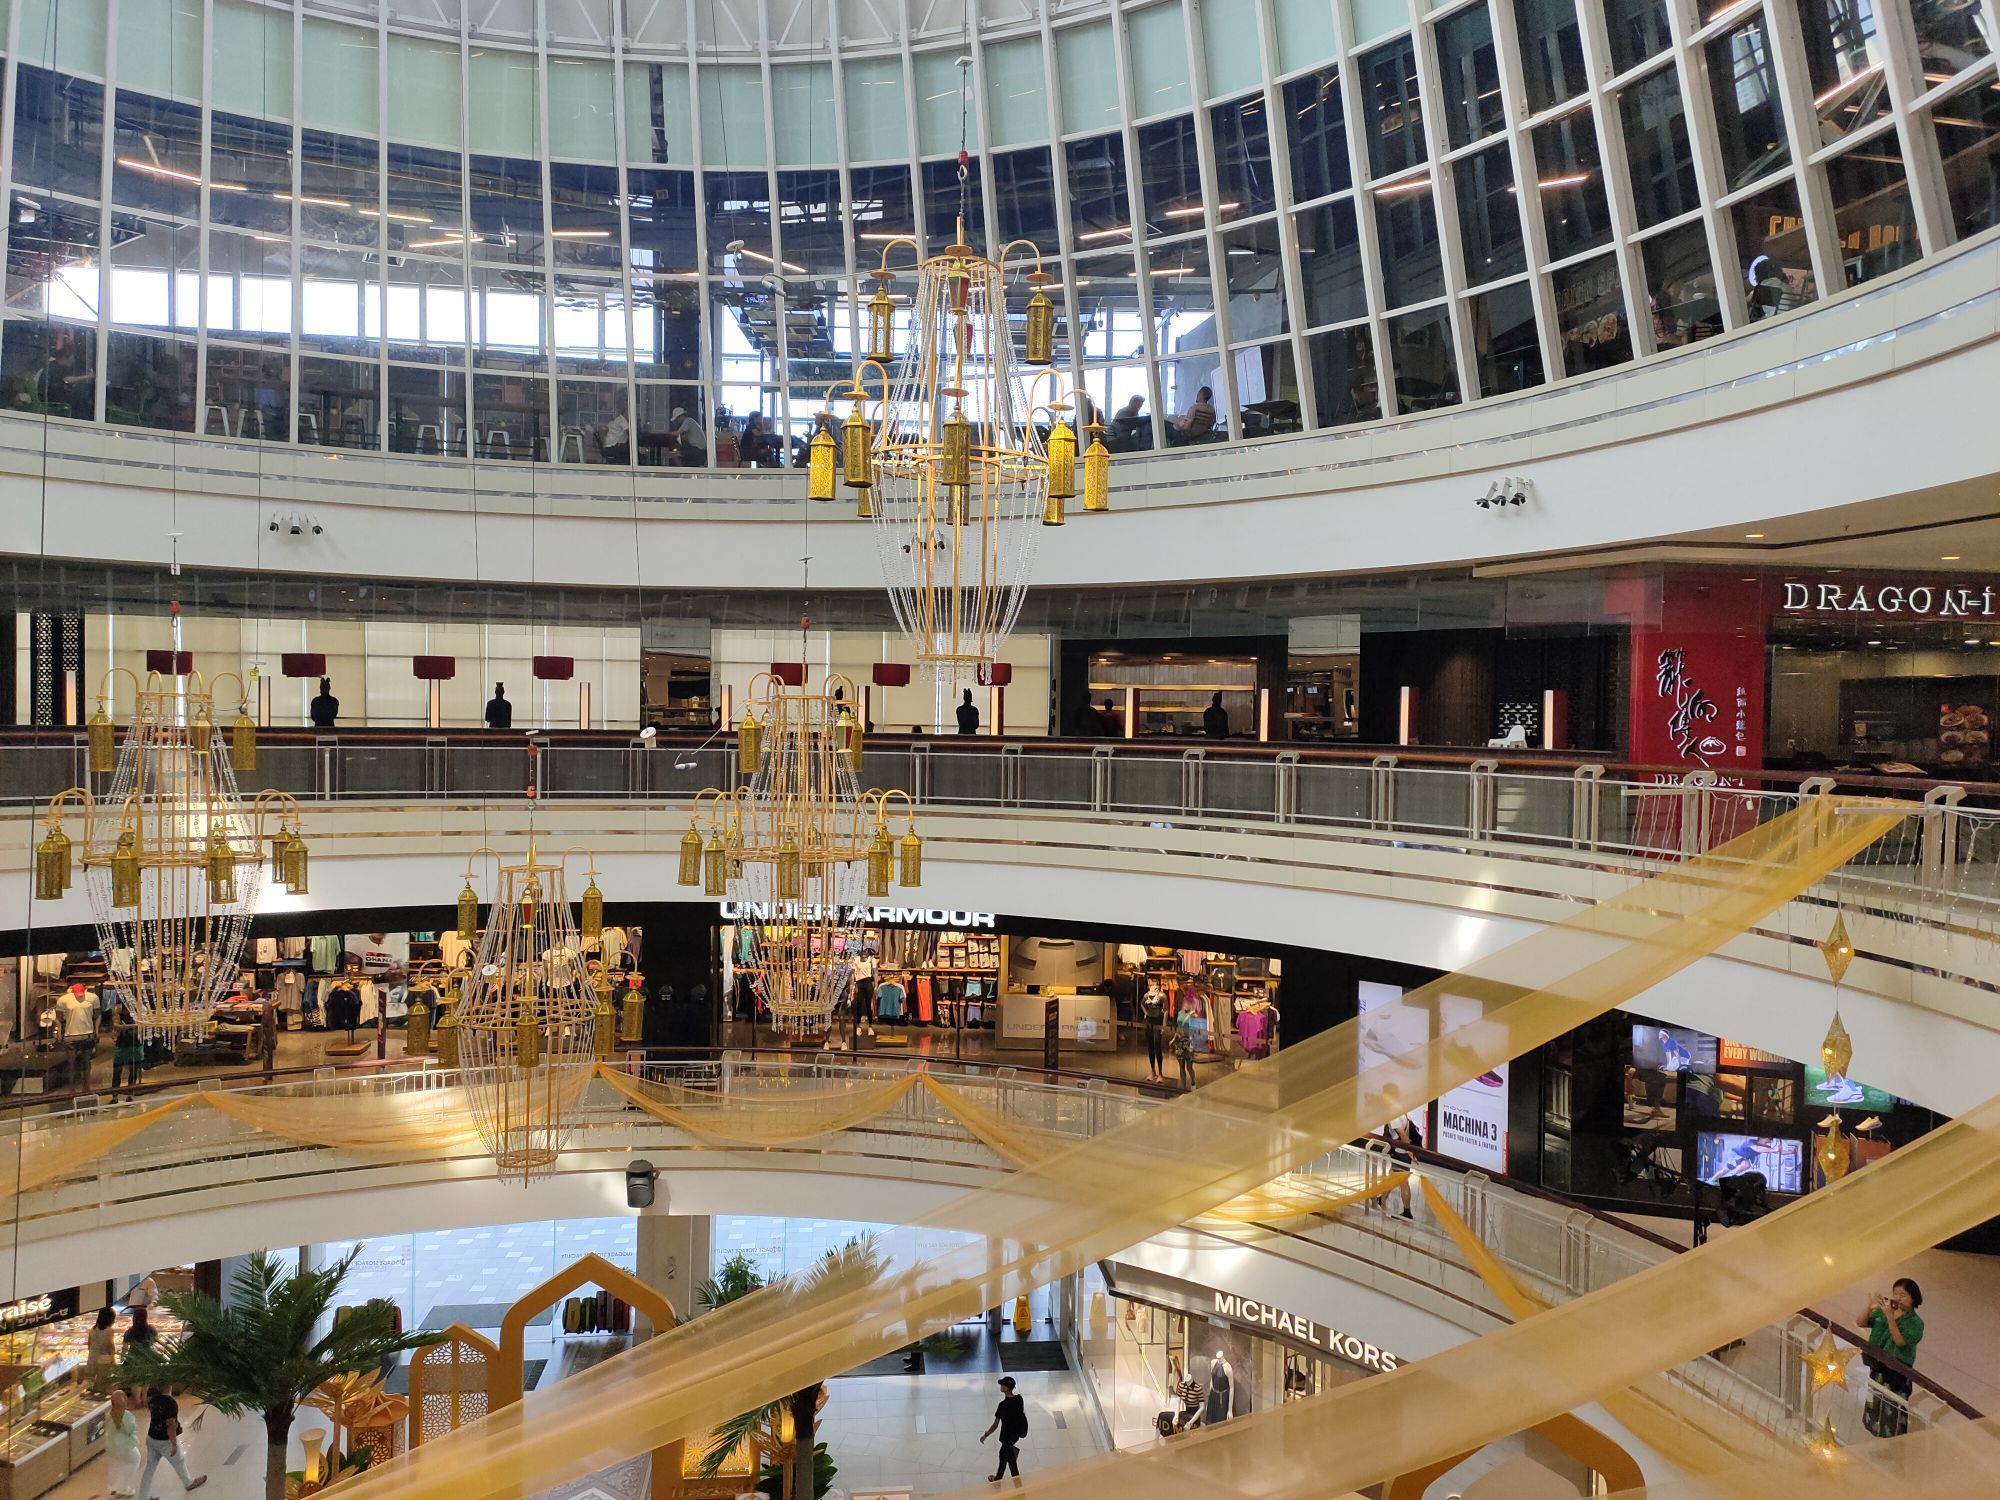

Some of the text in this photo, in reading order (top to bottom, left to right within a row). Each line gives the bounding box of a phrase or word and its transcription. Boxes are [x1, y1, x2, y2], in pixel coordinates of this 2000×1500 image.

[847, 905, 996, 928] ARMOUR
[1723, 1046, 1748, 1060] EVERY
[1443, 1111, 1489, 1139] MACHINA
[1491, 1123, 1498, 1141] 3
[1215, 1292, 1399, 1373] MICHAEL KORS
